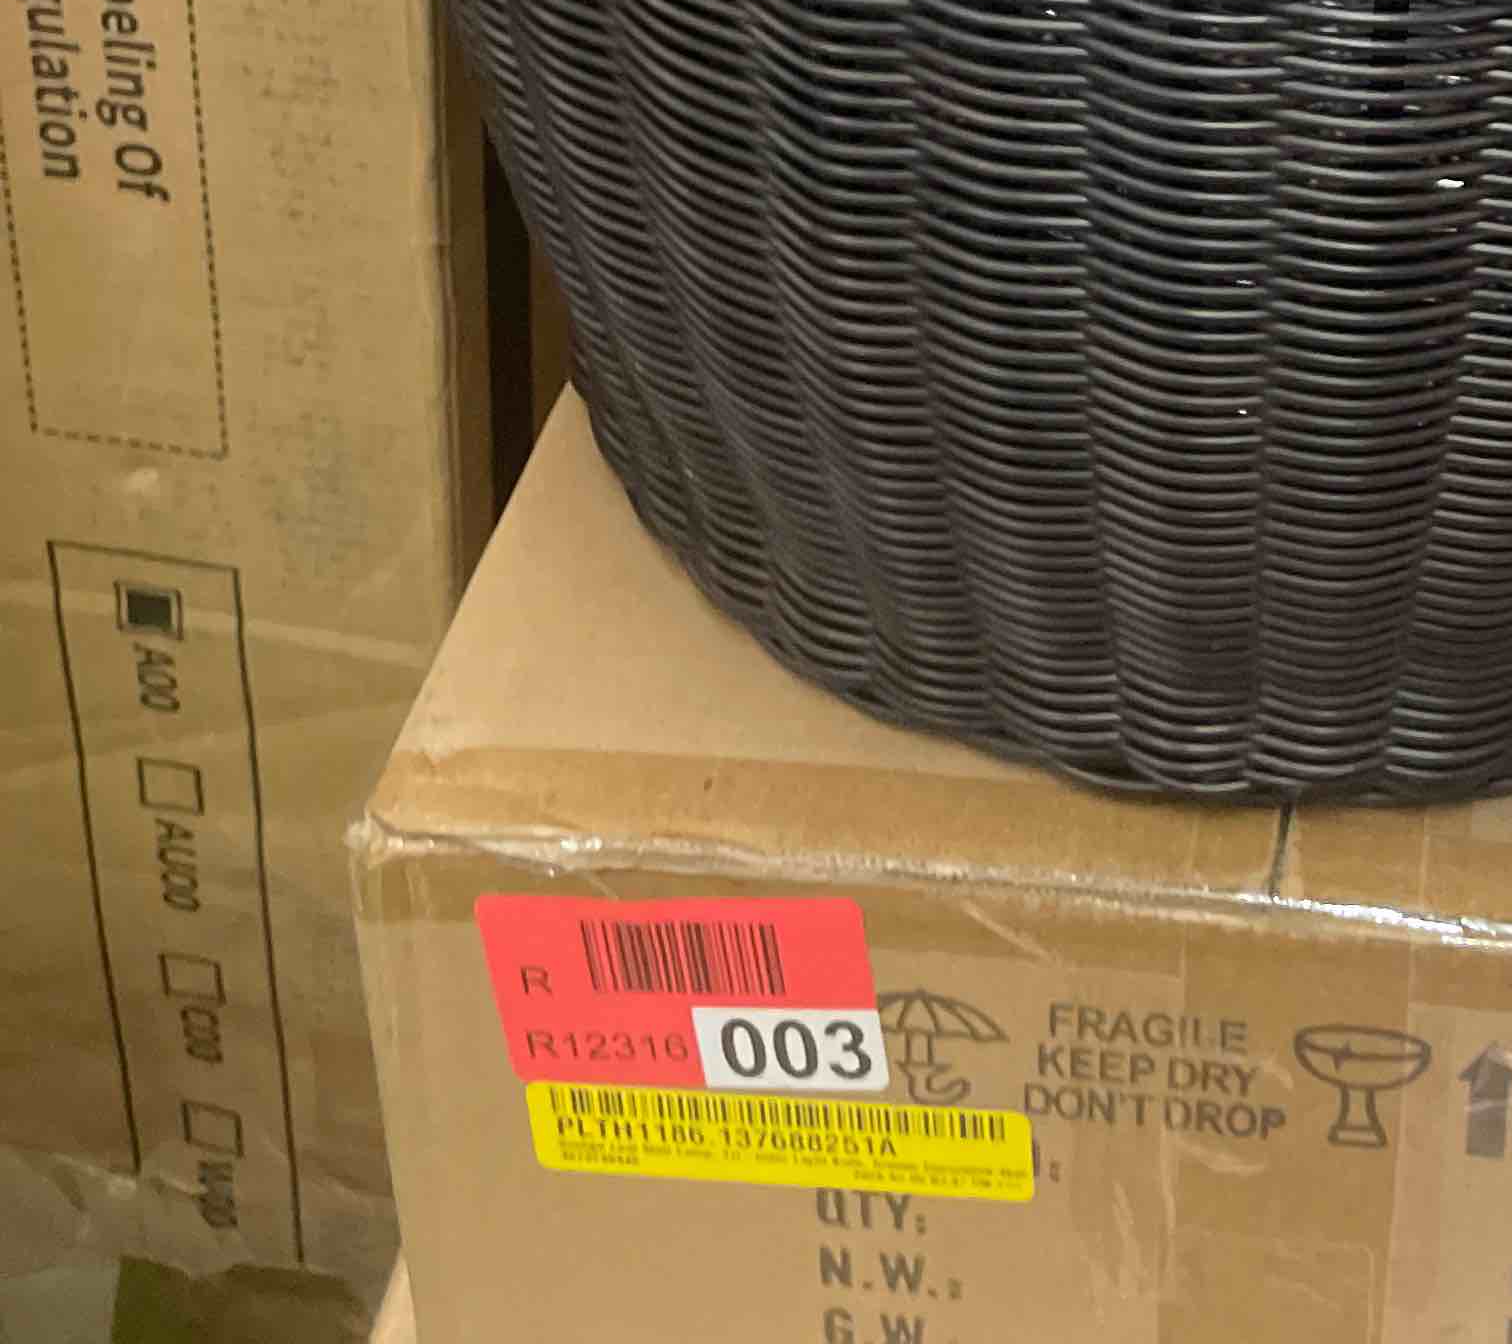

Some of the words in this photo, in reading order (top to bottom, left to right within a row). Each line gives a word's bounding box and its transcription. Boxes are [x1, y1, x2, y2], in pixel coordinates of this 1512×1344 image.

[115, 143, 171, 203] Of
[520, 966, 553, 995] R
[526, 1030, 689, 1063] R12316
[721, 1016, 873, 1080] 003
[1049, 1002, 1248, 1055] FRAGILE
[1037, 1043, 1155, 1085] KEEP
[1167, 1056, 1260, 1097] DRY
[1024, 1082, 1154, 1127] DON'T
[1164, 1095, 1287, 1141] DROP
